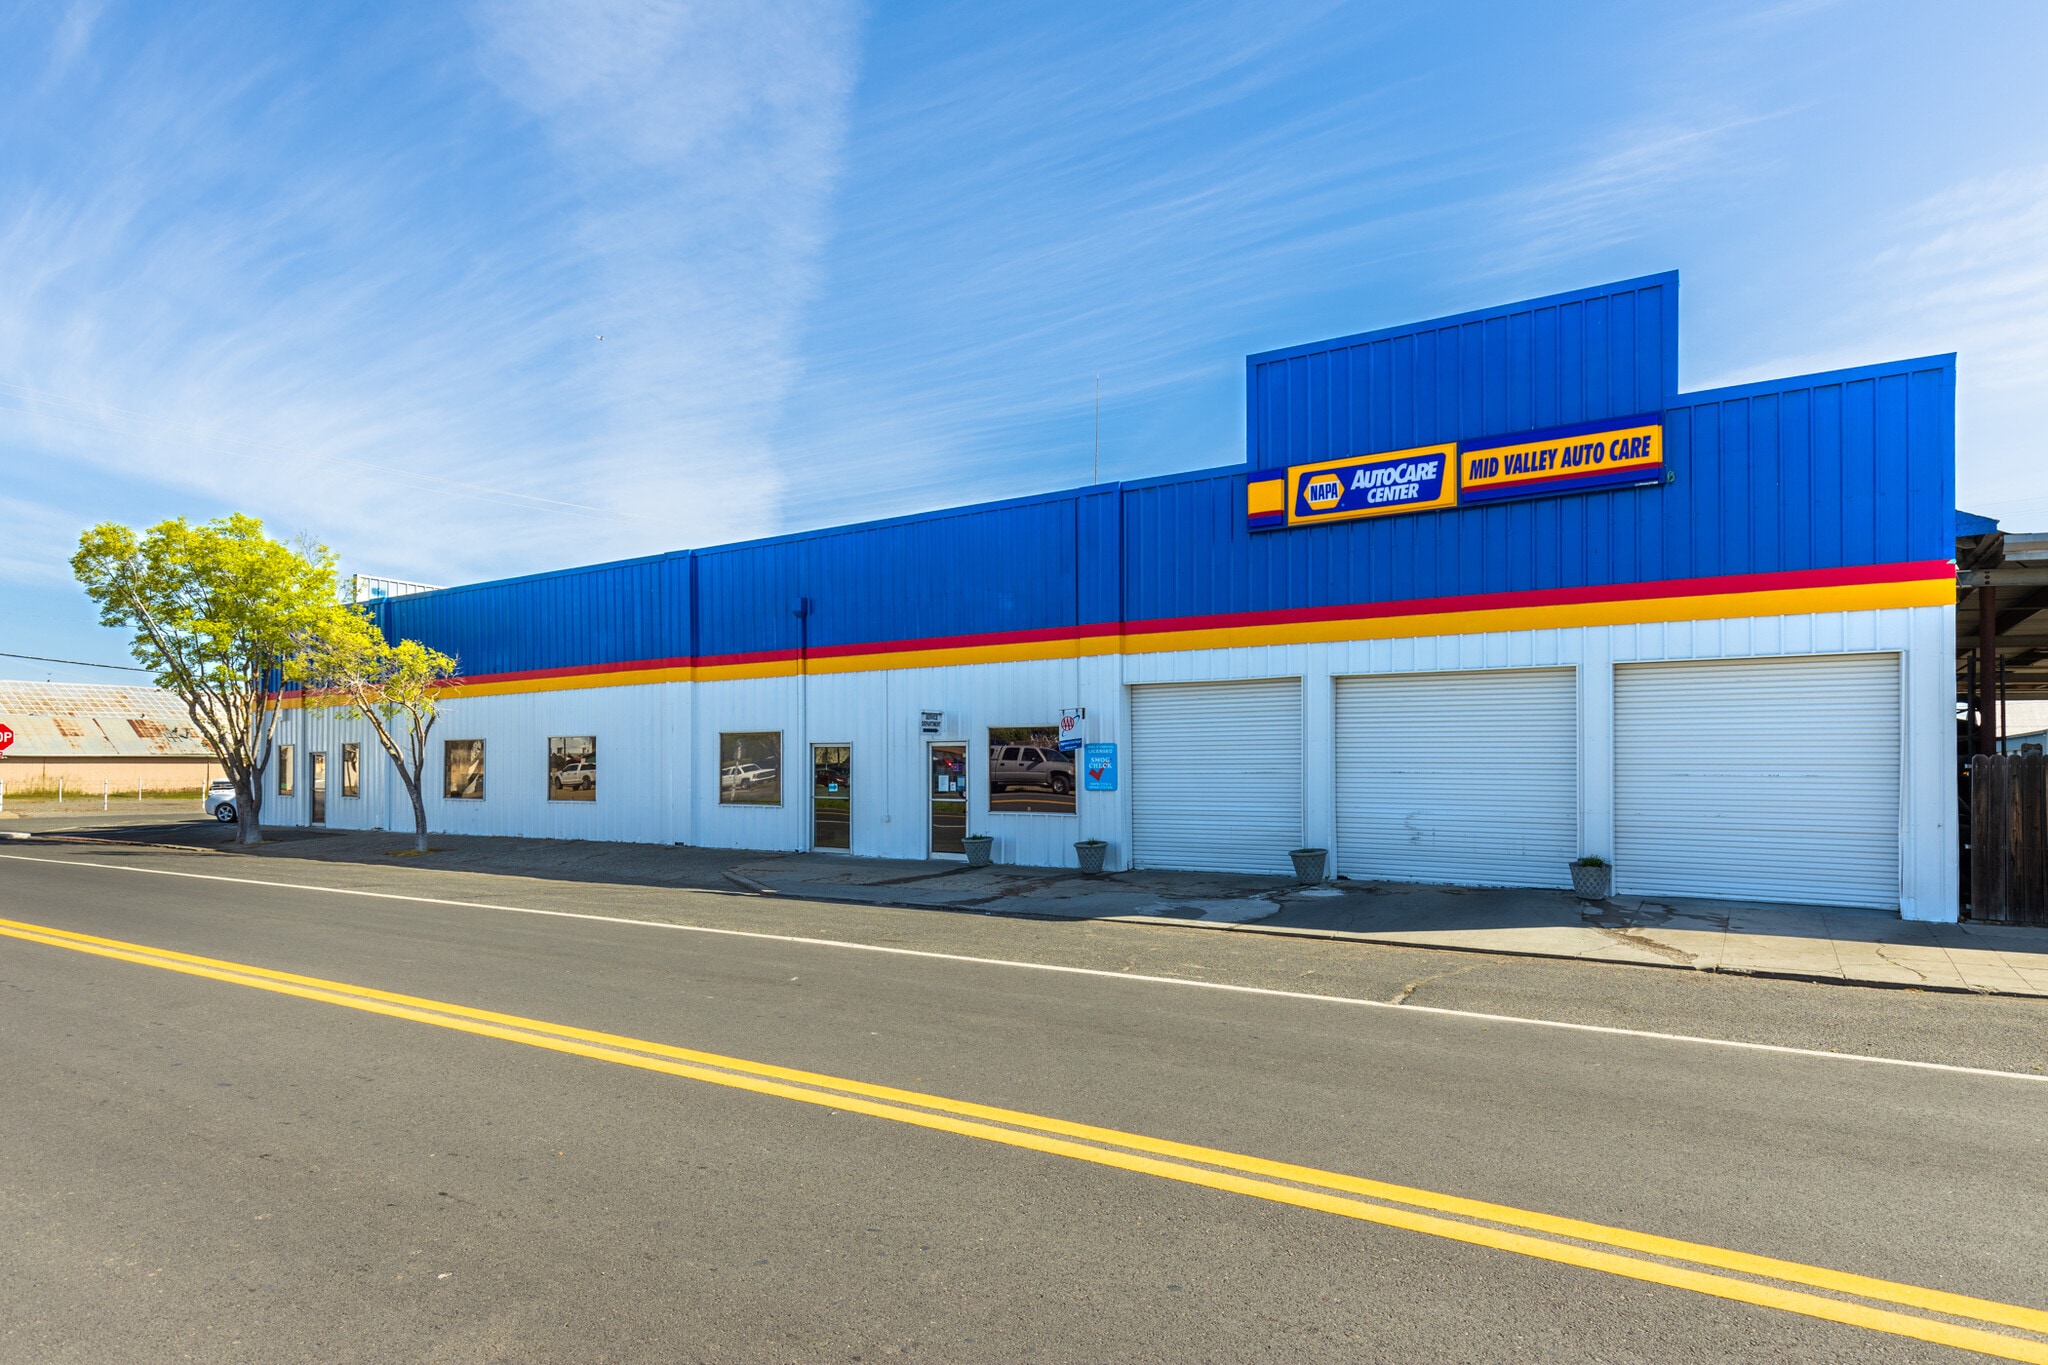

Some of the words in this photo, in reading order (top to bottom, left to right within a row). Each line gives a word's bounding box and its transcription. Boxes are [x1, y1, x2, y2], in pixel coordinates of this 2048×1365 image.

[1469, 457, 1499, 480] MID
[1504, 448, 1558, 475] VALLEY
[1560, 442, 1605, 468] AUTO
[1609, 435, 1651, 461] CARE
[1310, 482, 1339, 501] NAPA
[1367, 483, 1419, 503] CENTER
[0, 731, 12, 743] OP
